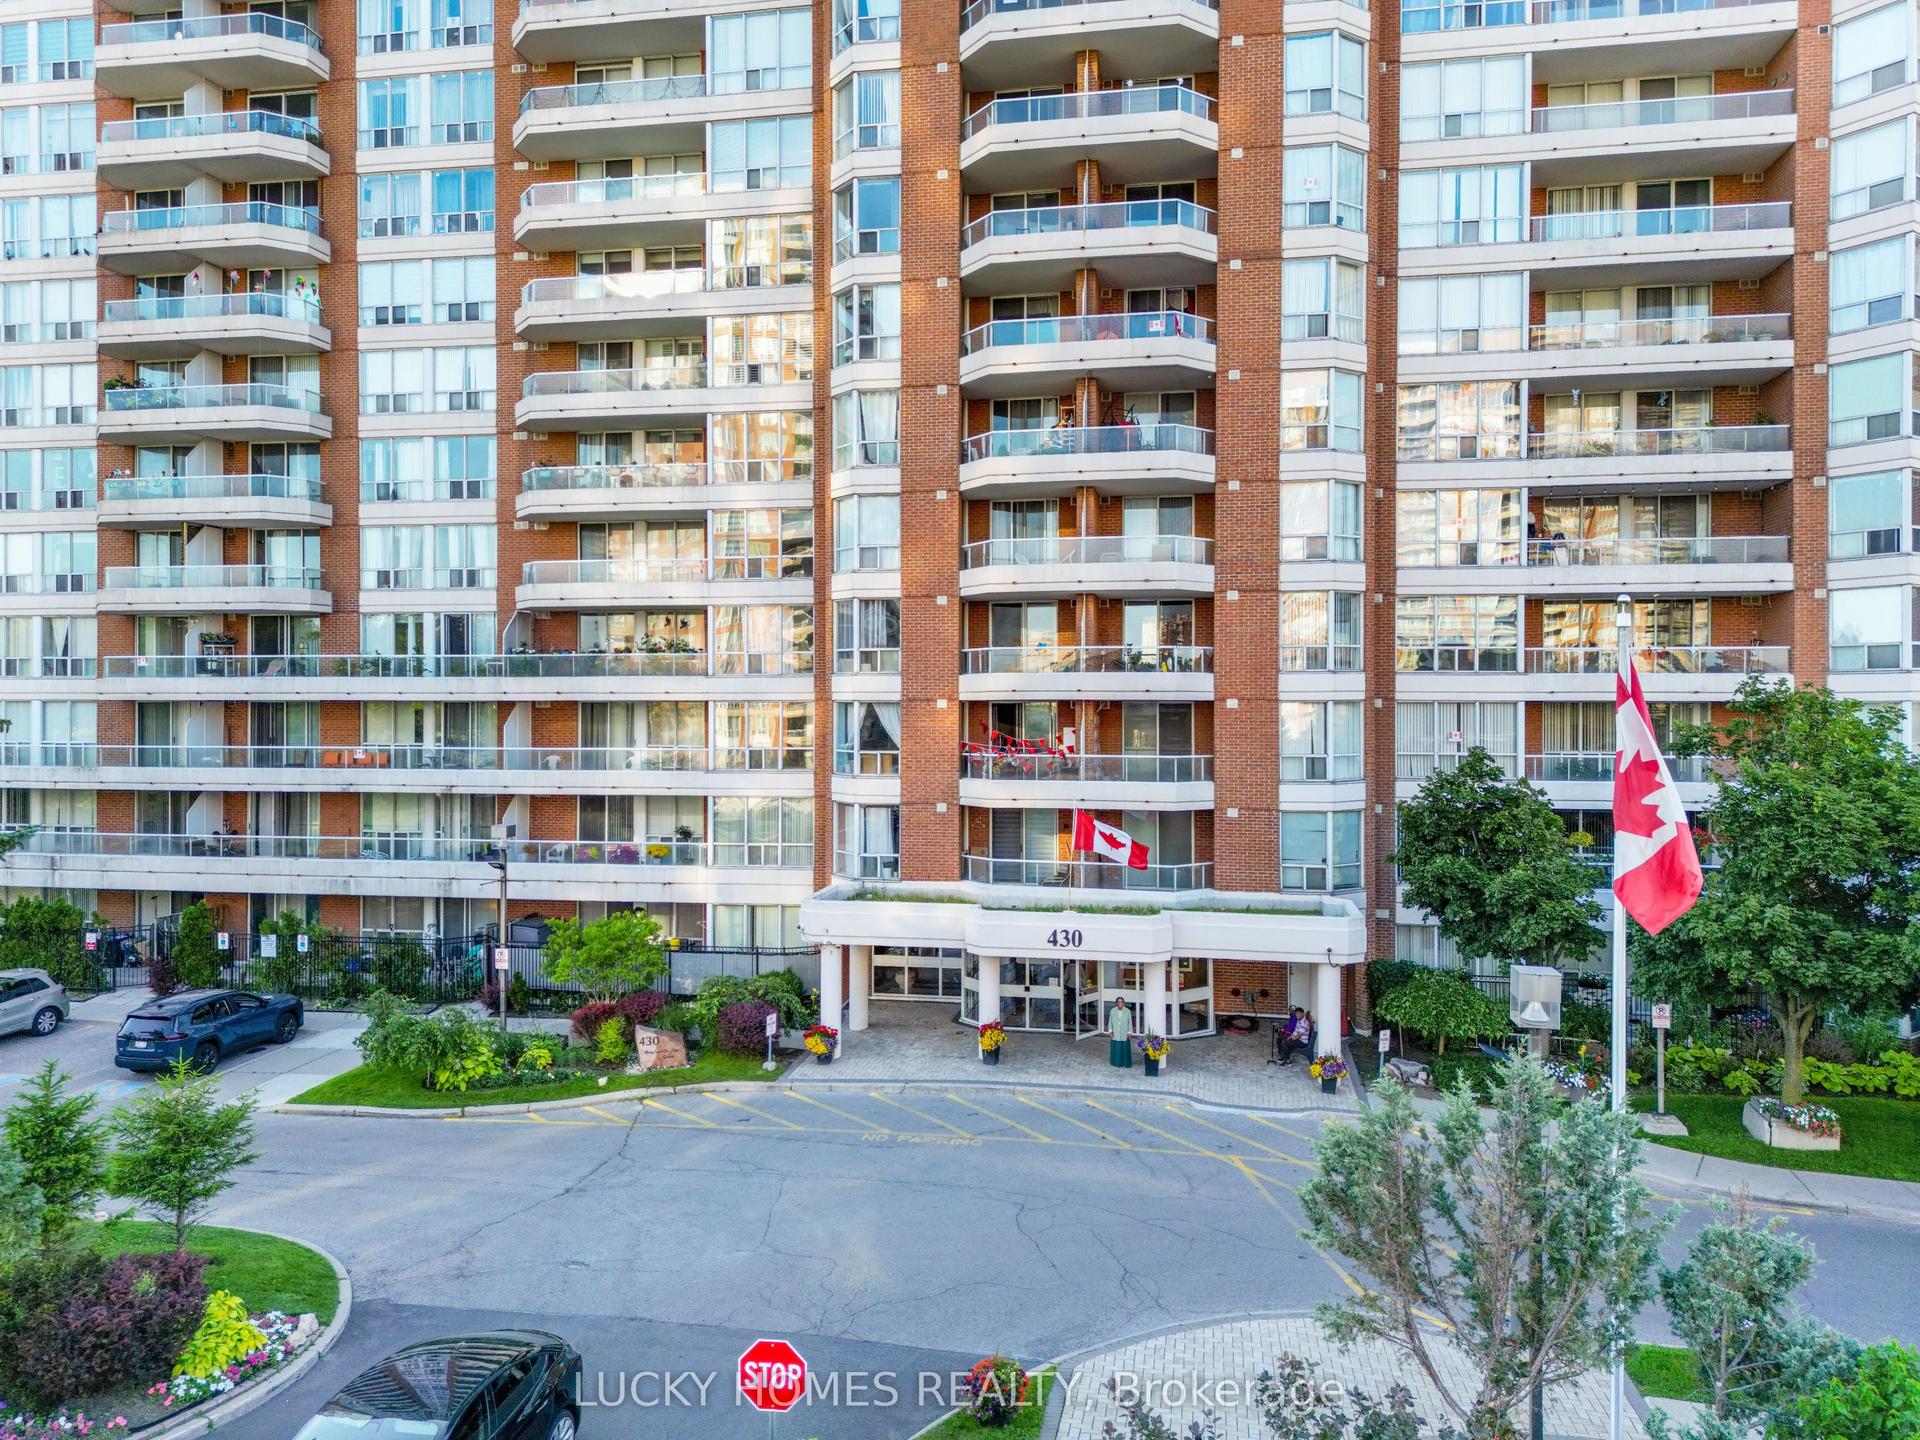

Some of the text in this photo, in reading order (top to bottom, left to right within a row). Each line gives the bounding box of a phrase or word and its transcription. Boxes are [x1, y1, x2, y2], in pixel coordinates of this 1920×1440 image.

[1047, 929, 1083, 948] 430
[639, 1036, 660, 1046] 430
[861, 1134, 984, 1147] NO PARKING
[744, 1361, 801, 1390] STOP
